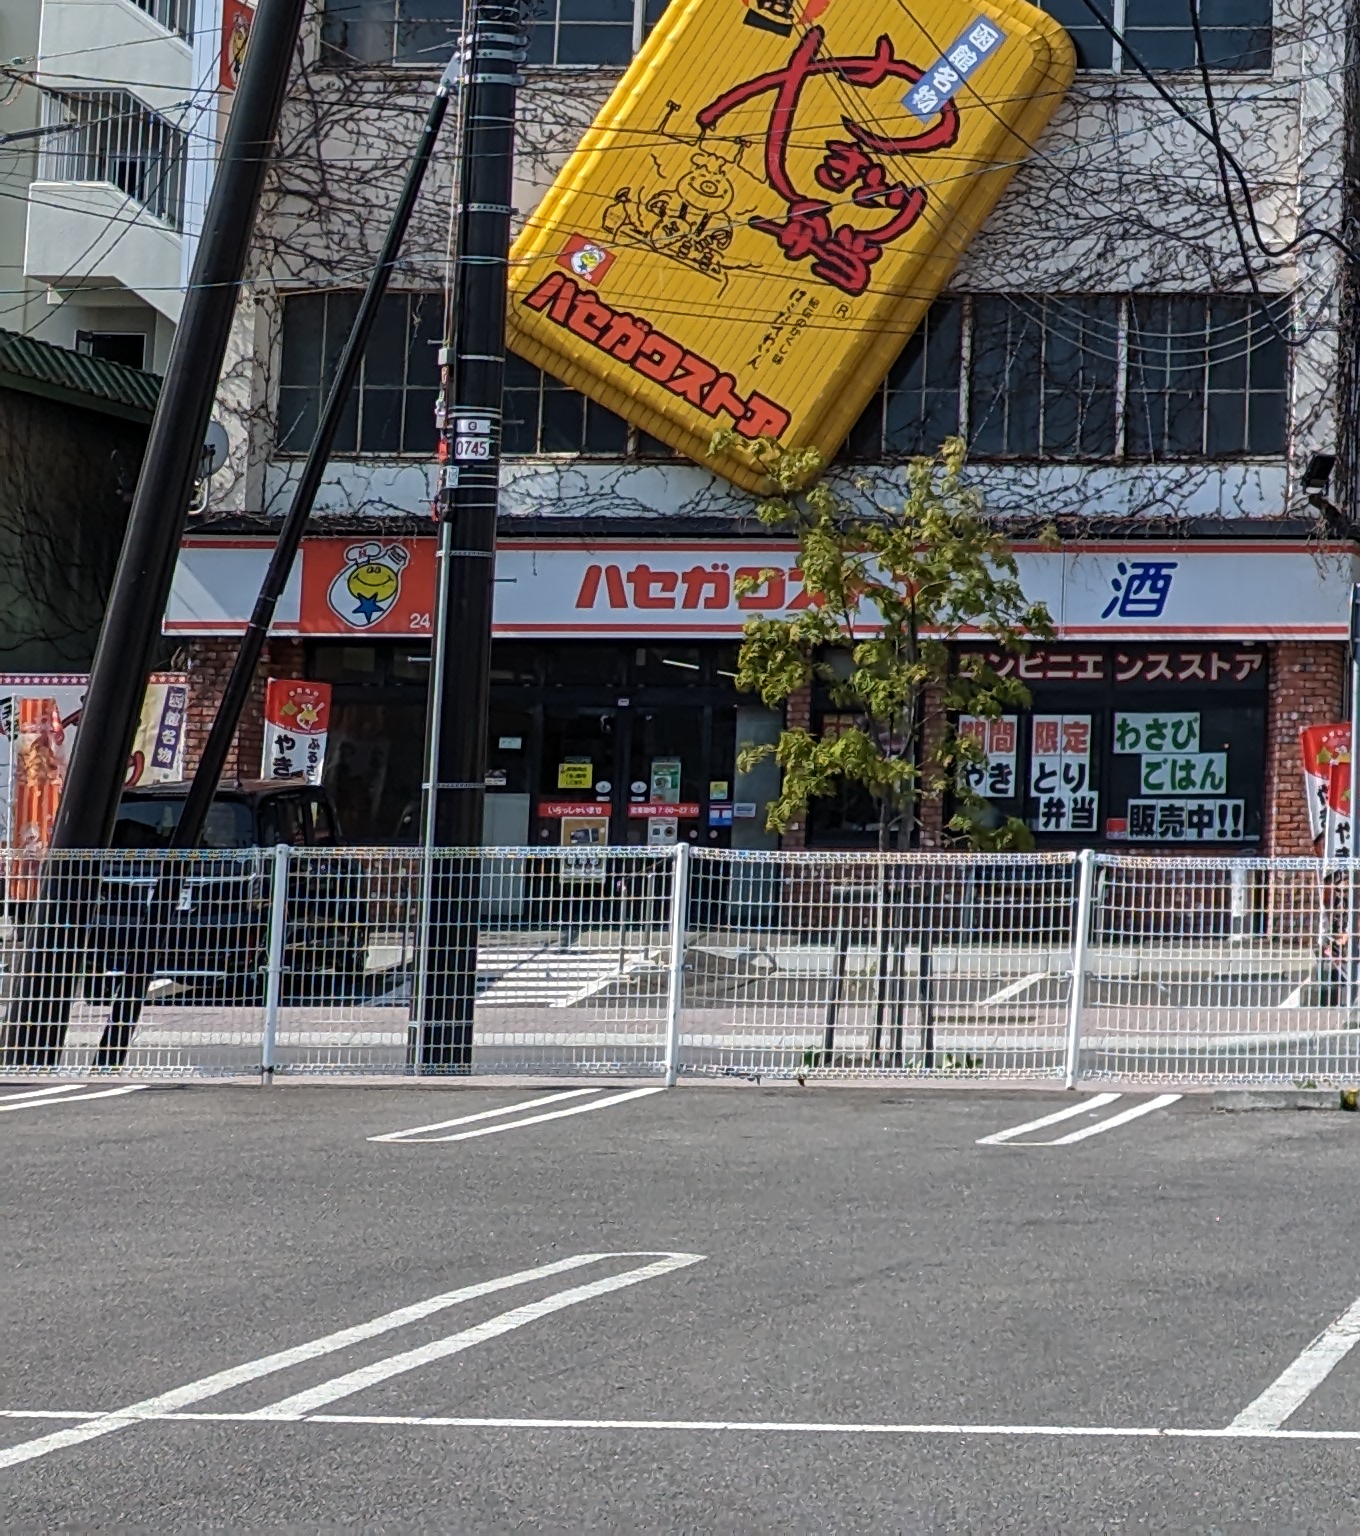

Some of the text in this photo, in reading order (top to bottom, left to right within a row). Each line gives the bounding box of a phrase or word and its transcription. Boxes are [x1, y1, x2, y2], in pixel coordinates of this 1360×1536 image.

[910, 24, 999, 116] 函館名物
[520, 270, 791, 440] ハセガワストア
[455, 440, 488, 457] 0745
[1100, 561, 1178, 619] 酒
[409, 612, 431, 630] 24
[959, 720, 1092, 756] 期間 限定
[1115, 717, 1200, 753] わさび
[963, 762, 1087, 796] やき とり
[1143, 758, 1226, 792] ごはん
[1040, 797, 1097, 831] 弁当
[1128, 801, 1243, 839] 販売中!!
